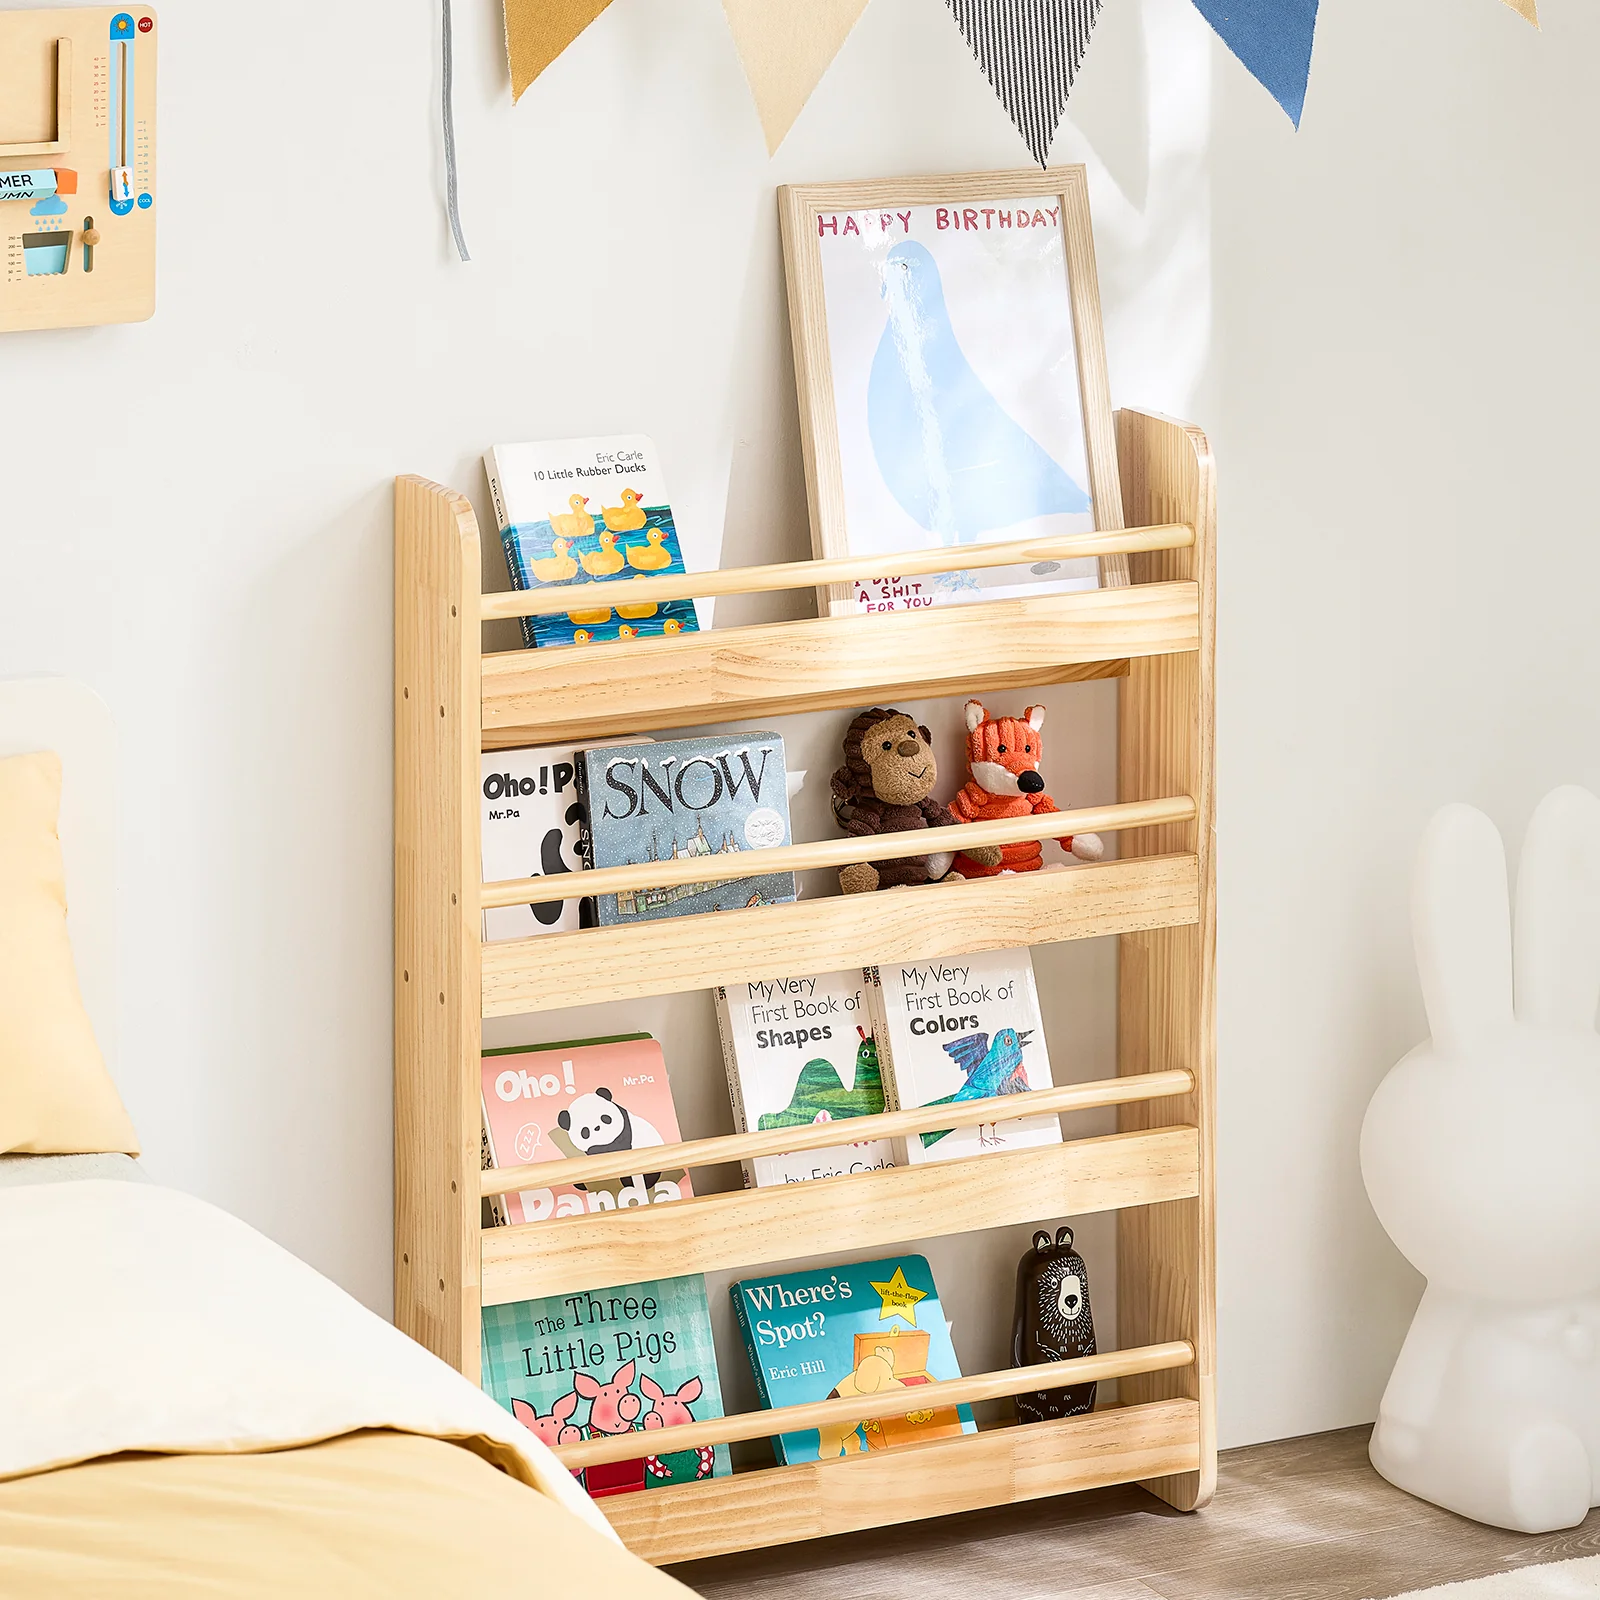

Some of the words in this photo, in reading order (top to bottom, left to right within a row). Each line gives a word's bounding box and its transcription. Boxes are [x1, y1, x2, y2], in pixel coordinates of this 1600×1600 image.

[936, 206, 1059, 231] BIRTHDAY
[596, 452, 615, 463] Eric
[616, 450, 643, 461] Carle
[534, 470, 544, 480] 10
[547, 469, 574, 480] Little
[576, 466, 612, 477] Rubber
[614, 463, 646, 474] Ducks
[859, 590, 870, 602] A
[881, 584, 922, 598] SHIT
[867, 602, 894, 613] FOR
[903, 597, 932, 609] YOU
[602, 748, 774, 820] SNOW
[489, 809, 520, 820] Mr.Pa
[901, 967, 928, 990] My
[929, 964, 970, 985] Very
[748, 980, 774, 1002] My
[776, 978, 816, 996] Very
[905, 992, 942, 1011] First
[947, 984, 992, 1006] Book
[998, 980, 1014, 1000] of
[752, 1004, 789, 1024] First
[794, 995, 839, 1018] Book
[844, 991, 861, 1010] of
[910, 1014, 980, 1035] Colors
[756, 1025, 832, 1049] Shapes
[495, 1060, 577, 1102] Oho!
[623, 1074, 654, 1086] Mr.Pa
[785, 1174, 805, 1184] b
[518, 1174, 682, 1222] Panda
[745, 1276, 853, 1312] Where's
[880, 1289, 919, 1302] lift-the-flap
[892, 1300, 907, 1308] book
[535, 1314, 566, 1336] The
[565, 1293, 657, 1327] Three
[757, 1312, 826, 1349] Spot?
[522, 1339, 605, 1377] Little
[613, 1330, 677, 1363] Pigs
[770, 1366, 798, 1380] Eric
[799, 1360, 827, 1376] Hill
